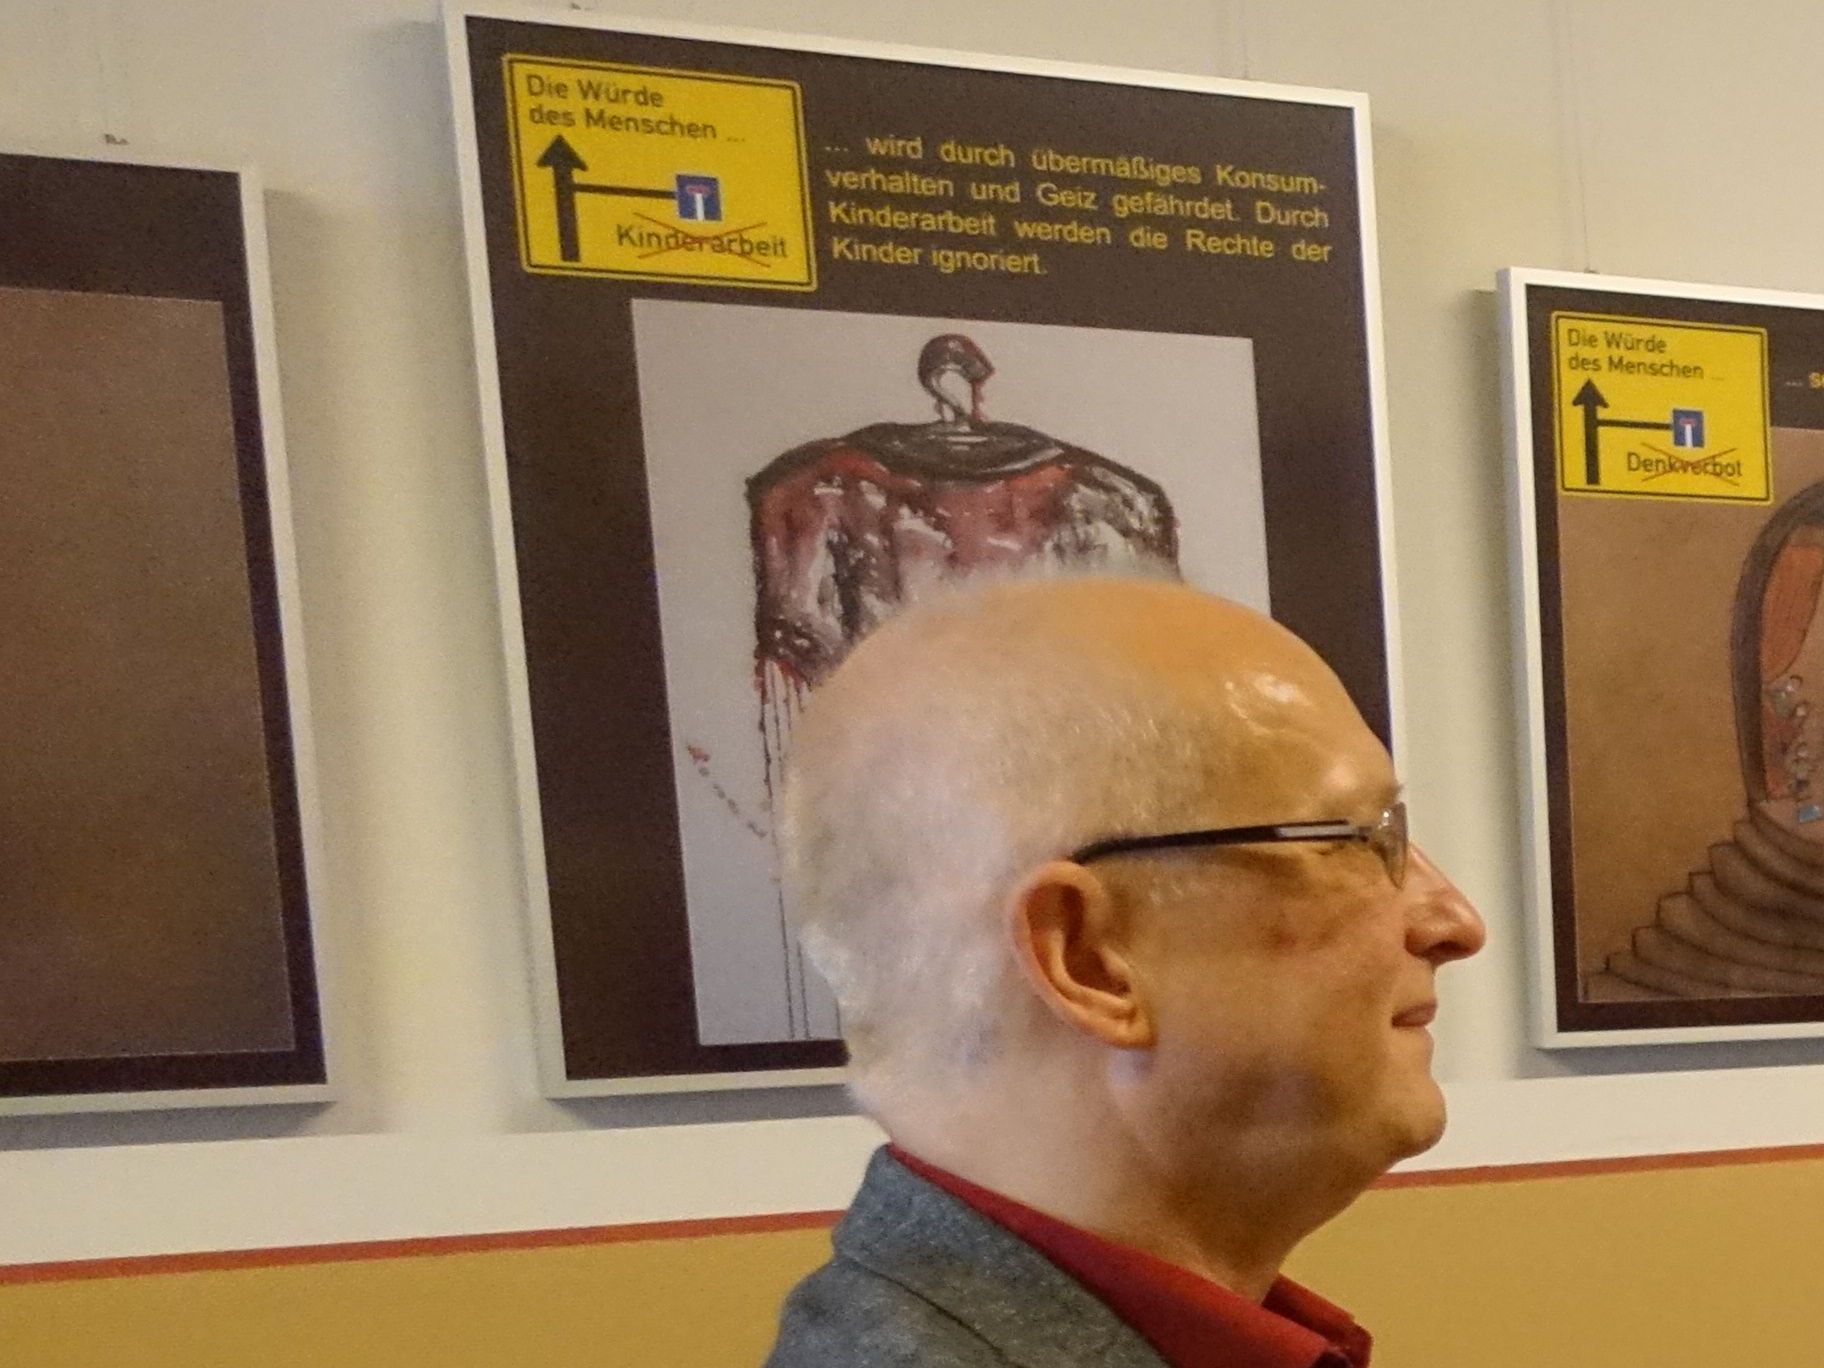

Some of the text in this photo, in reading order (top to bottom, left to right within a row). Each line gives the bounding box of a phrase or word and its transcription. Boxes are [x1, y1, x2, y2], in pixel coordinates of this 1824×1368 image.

[526, 74, 664, 107] Die Würde
[530, 104, 575, 128] des
[585, 107, 717, 139] Menschen
[866, 134, 923, 160] wird
[940, 140, 1016, 168] durch
[1032, 146, 1202, 187] übermäßiges
[1215, 163, 1327, 194] Konsum-
[825, 167, 1329, 228] verhalten und Geiz gefährdet. Durch
[616, 224, 788, 259] Kinderarbeit
[828, 201, 1332, 263] Kinderarbeit werden die Rechte der
[831, 236, 1048, 274] Kinder ignoriert.
[1567, 328, 1667, 353] Die Würde
[1568, 352, 1601, 371] des
[1608, 355, 1704, 379] Menschen
[1627, 452, 1743, 478] Denkverbot
